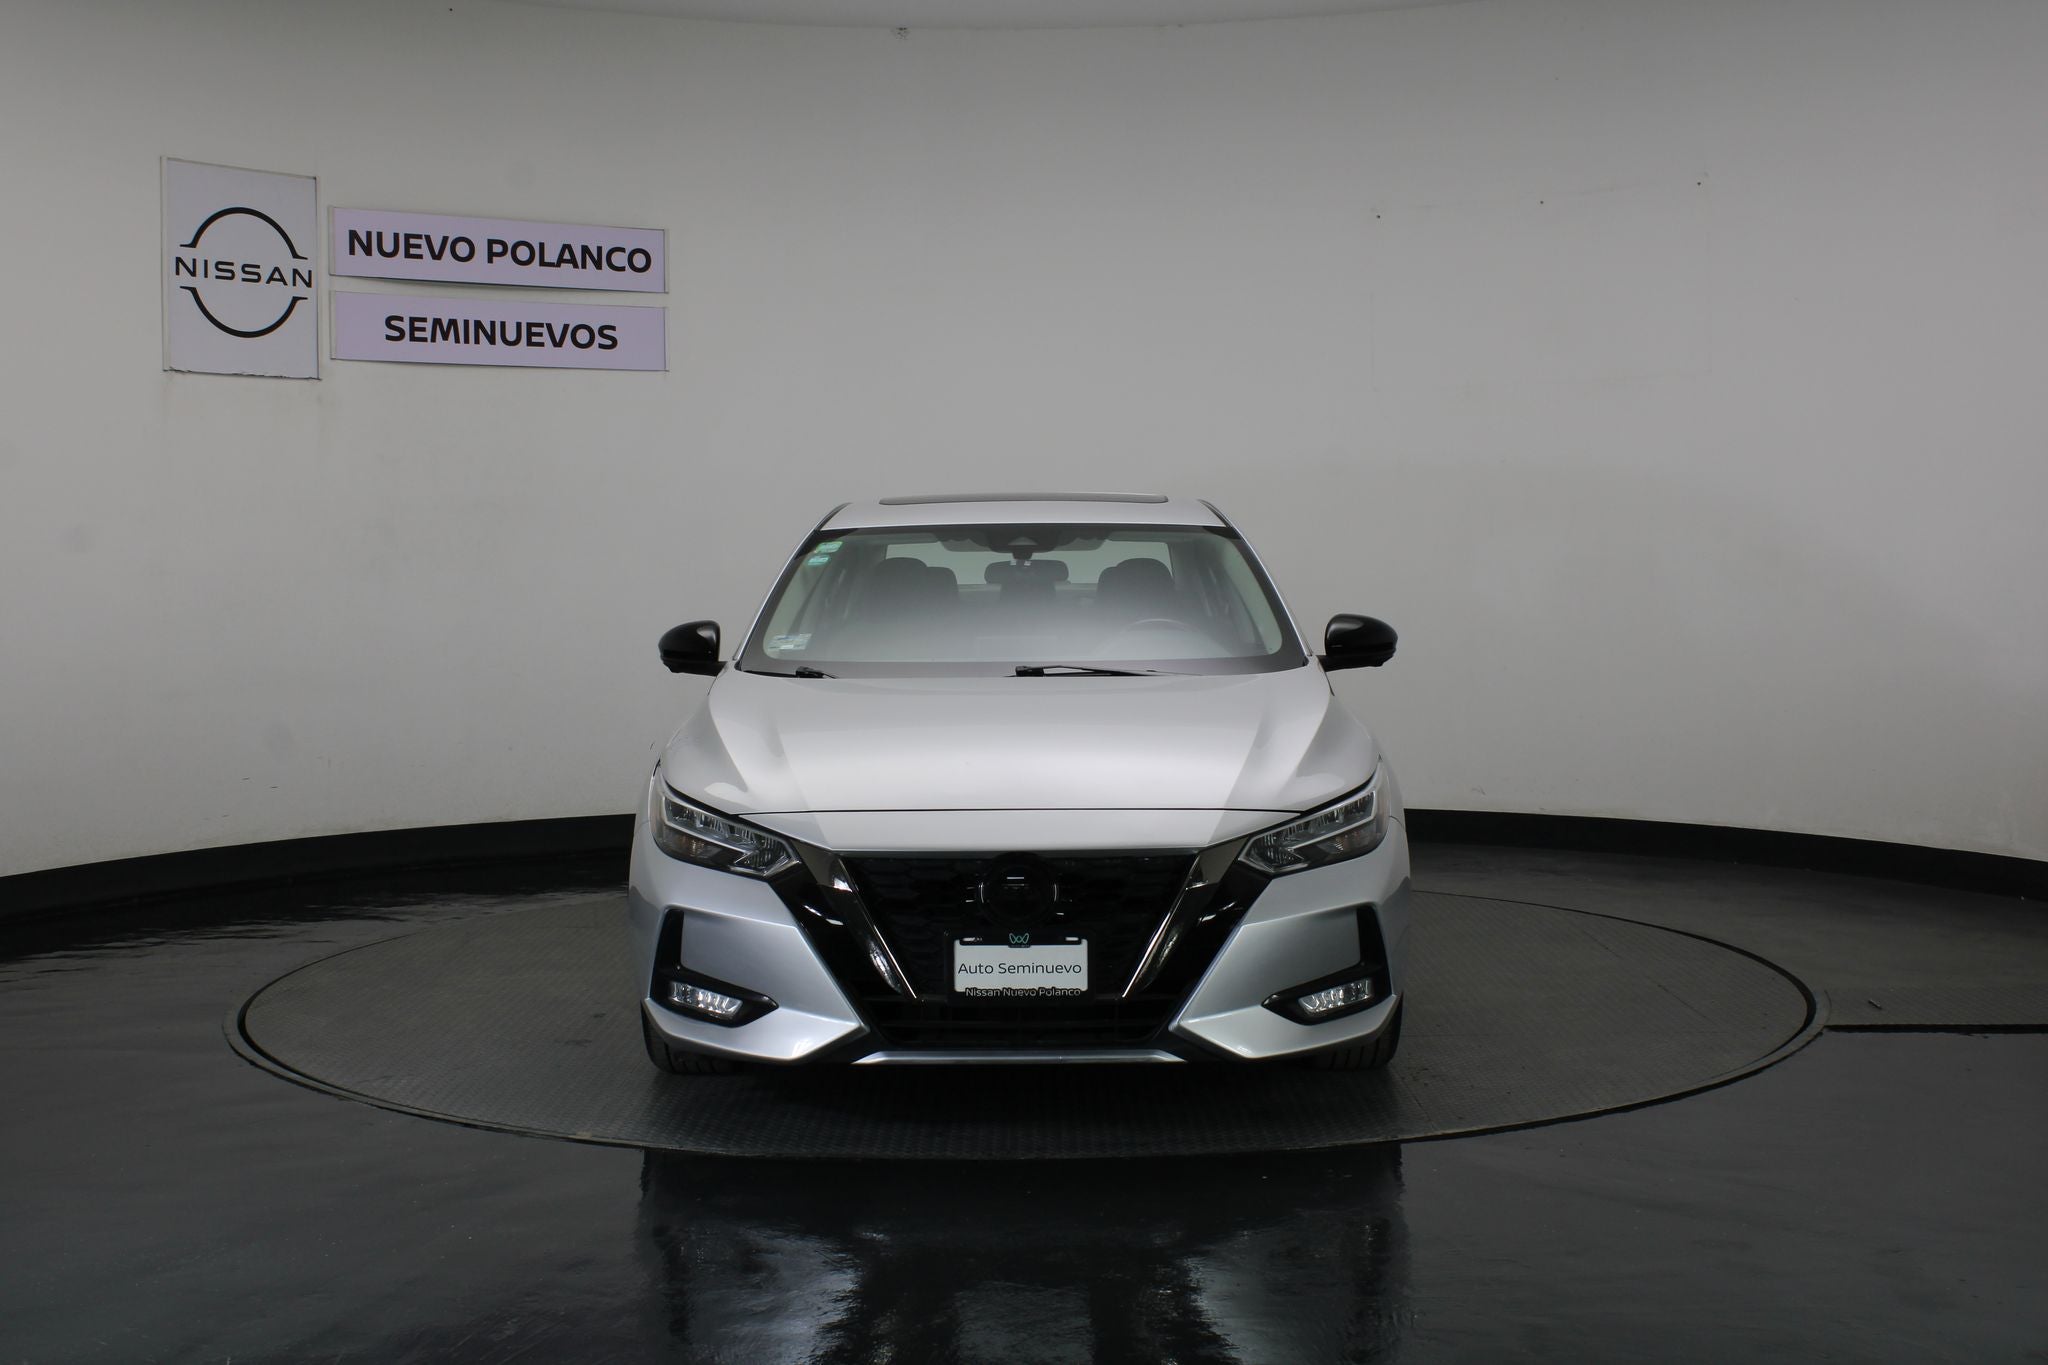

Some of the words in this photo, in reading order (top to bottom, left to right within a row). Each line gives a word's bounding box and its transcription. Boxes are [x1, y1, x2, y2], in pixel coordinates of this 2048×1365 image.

[348, 229, 476, 263] NUEVO
[487, 239, 652, 273] POLANCO
[175, 256, 313, 288] NISSAN
[384, 315, 618, 351] SEMINUEVOS
[958, 963, 994, 974] Auto
[998, 962, 1082, 974] Seminuevo
[966, 988, 1000, 997] Nissan
[1003, 988, 1036, 997] Nuevo
[1039, 987, 1081, 997] Polanco
